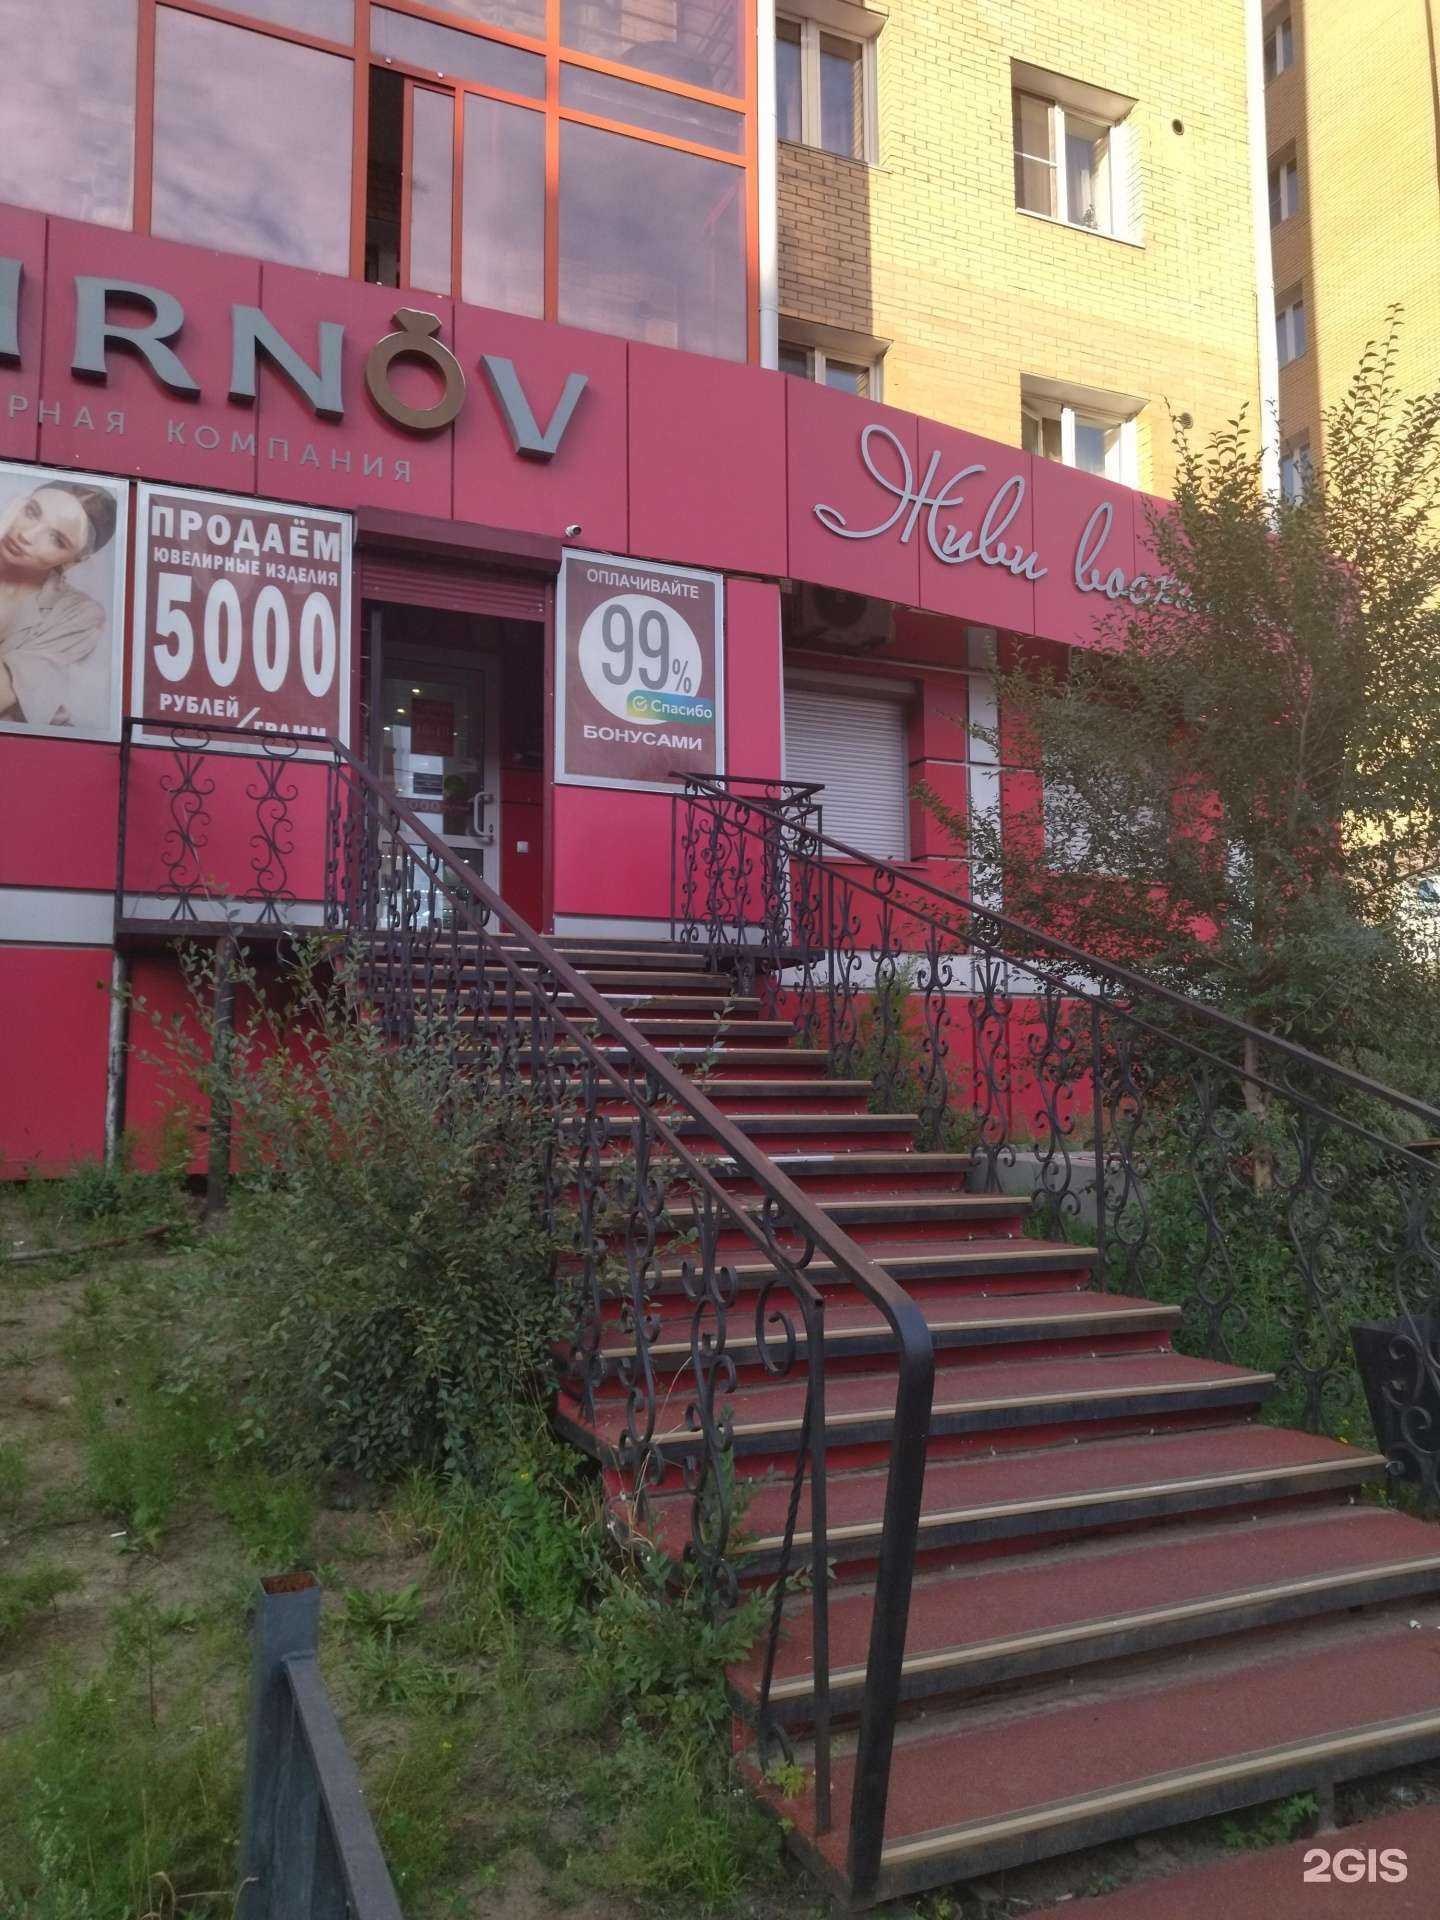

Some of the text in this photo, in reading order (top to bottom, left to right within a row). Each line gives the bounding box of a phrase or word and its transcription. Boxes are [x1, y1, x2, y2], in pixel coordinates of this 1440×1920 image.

[166, 419, 414, 484] КОМПАНИЯ
[813, 424, 1048, 580] Живи
[151, 505, 341, 562] ПРОДАЁМ
[154, 546, 338, 586] ЮВЕЛИРНЫЕ ИЗДЕЛИЯ
[586, 568, 700, 599] ОПЛАЧИВАЙТЕ
[153, 572, 337, 697] 5000
[601, 603, 692, 693] 99%
[583, 725, 702, 751] БОНУСАМИ
[651, 700, 713, 719] Спасибо
